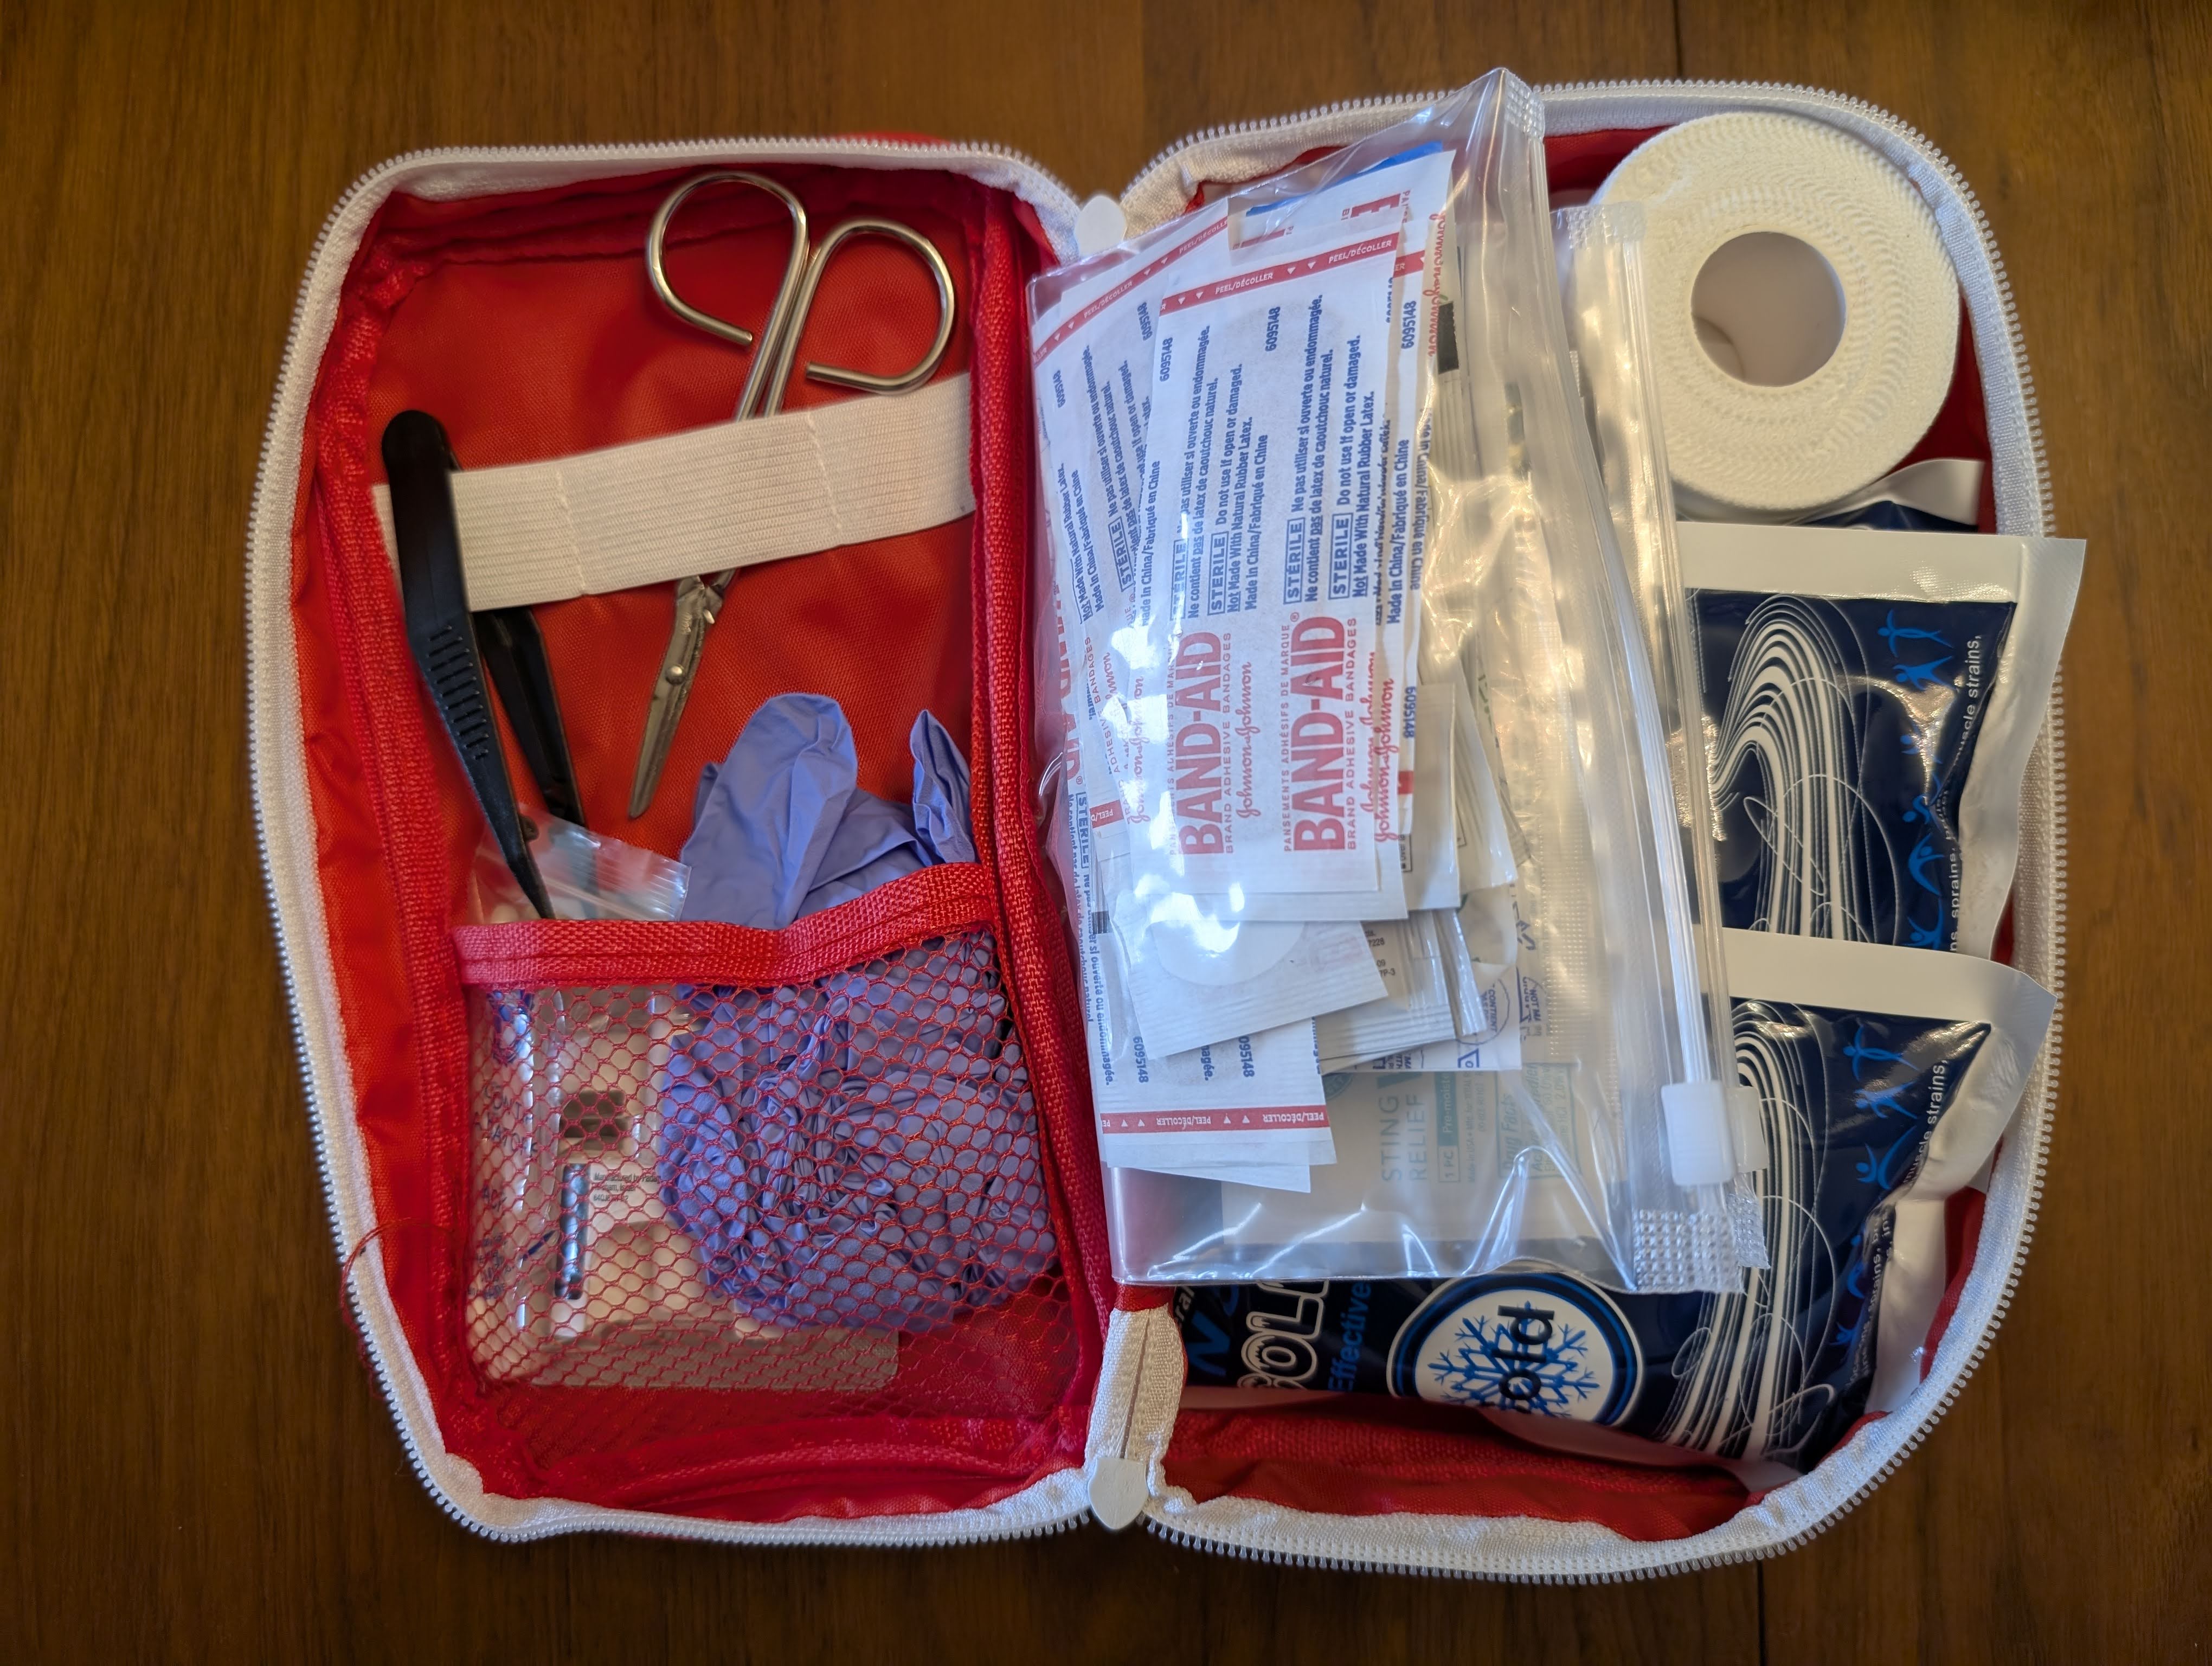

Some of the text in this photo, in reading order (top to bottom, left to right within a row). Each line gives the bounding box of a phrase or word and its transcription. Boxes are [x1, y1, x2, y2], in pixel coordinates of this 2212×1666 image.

[1326, 240, 1392, 263] PEEL/DÉCOLLER
[1216, 272, 1273, 294] PEEL/DÉCOLLER
[1137, 302, 1154, 341] 6095148
[1265, 306, 1281, 351] 6095148
[1305, 295, 1322, 367] endommagée.
[1401, 300, 1417, 349] 6095148
[1159, 337, 1173, 382] 6095148
[1193, 326, 1210, 393] endommagée.
[1304, 368, 1315, 382] ou
[1090, 401, 1100, 414] ou
[1191, 395, 1200, 409] ou
[1226, 364, 1242, 415] damaged.
[1301, 383, 1313, 424] ouverte
[1092, 414, 1105, 445] ouverte
[1187, 411, 1199, 448] ouverte
[1224, 430, 1236, 457] open
[1226, 418, 1236, 428] or
[1297, 425, 1310, 435] si
[1097, 446, 1107, 456] si
[1100, 455, 1113, 486] utiliser
[1101, 381, 1137, 528] pas de latex de caoutchouc naturel.
[1295, 437, 1309, 473] utiliser
[1333, 336, 1361, 594] STERILE Do not use if open or damaged.
[1105, 484, 1117, 502] pas
[1148, 461, 1160, 490] Chine
[1180, 462, 1193, 496] utiliser
[1220, 469, 1231, 487] use
[1295, 475, 1307, 494] pas
[1305, 349, 1333, 601] Ne contient pas de latex de caoutchouc naturel.
[1352, 392, 1374, 597] Not Made With Natural Rubber Latex.
[1108, 501, 1118, 517] Ne
[1148, 490, 1157, 504] en
[1188, 378, 1218, 618] Ne contient pas de latex de caoutchouc naturel.
[1215, 509, 1227, 525] Do
[1218, 489, 1229, 508] not
[1227, 417, 1252, 612] Not Made With Natural Rubber Latex.
[1291, 496, 1304, 512] Ne
[1057, 463, 1094, 621] Not Made With Natural Rubber Latex.
[1071, 470, 1104, 612] Made in China/Fabriqué en Chine
[1245, 435, 1268, 610] Made in China/Fabriqué en Chine
[1387, 440, 1409, 624] Made in China/Fabriqué en Chine
[1141, 506, 1157, 585] China/Fabriqué
[1140, 587, 1150, 598] in
[1211, 537, 1225, 610] STERILE
[1084, 637, 1101, 703] BANDAGES
[1964, 634, 1982, 699] strains,
[1166, 694, 1174, 707] DE
[1404, 686, 1416, 738] 6095148
[1175, 633, 1223, 854] BAND-AID
[1222, 633, 1233, 853] BRAND ADHESIVE BANDAGES
[1279, 625, 1291, 851] PANSEMENTS ADHÉSIFS DE MARQUE
[1291, 618, 1345, 850] BAND-AID
[1345, 618, 1356, 849] BRAND ADHESIVE BANDAGES
[1950, 847, 1963, 918] sprains,
[1089, 945, 1099, 954] si
[1091, 956, 1103, 995] ouverte
[1096, 997, 1104, 1010] ou
[1239, 1036, 1255, 1078] 095148
[1927, 1059, 1950, 1125] strains,
[1156, 1116, 1211, 1129] PEEL/DÉCOLLER
[1263, 1112, 1324, 1123] PEEL/DÉCOLLER
[1379, 1095, 1402, 1181] STING
[1406, 1094, 1427, 1181] RELIEF
[1489, 1305, 1555, 1407] old
